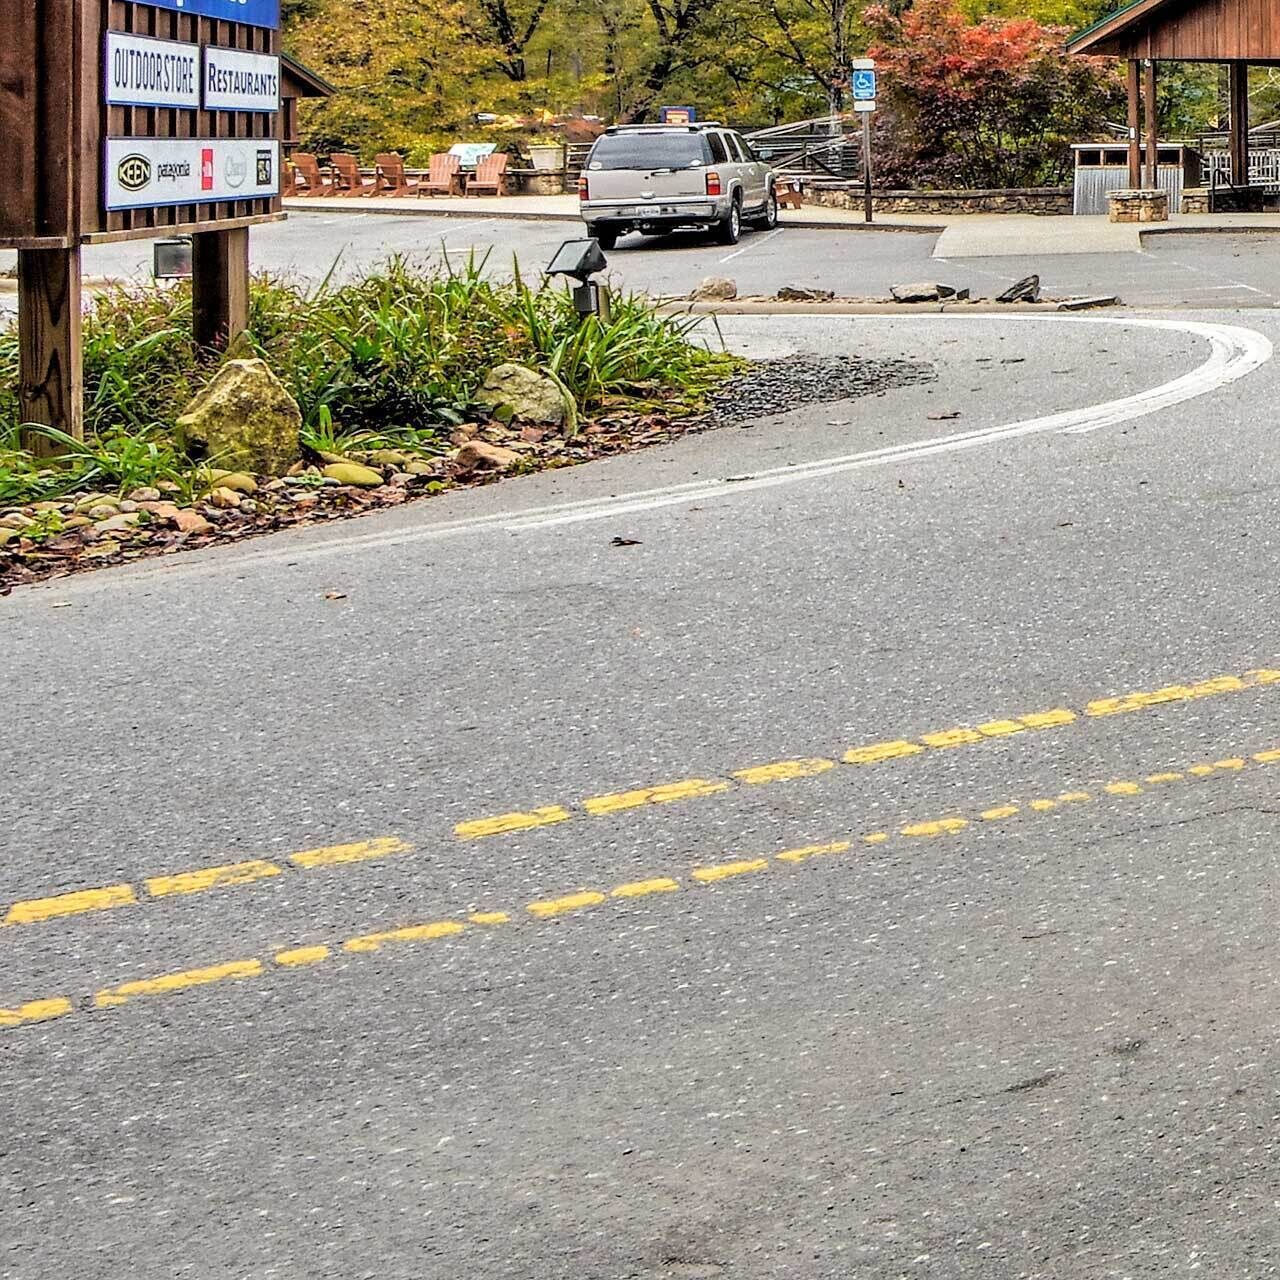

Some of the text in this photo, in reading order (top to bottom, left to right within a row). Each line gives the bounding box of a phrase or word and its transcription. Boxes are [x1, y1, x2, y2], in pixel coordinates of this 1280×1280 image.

[208, 62, 277, 97] RESTAURANTS
[119, 158, 151, 186] KEEN
[157, 160, 191, 182] patagonia
